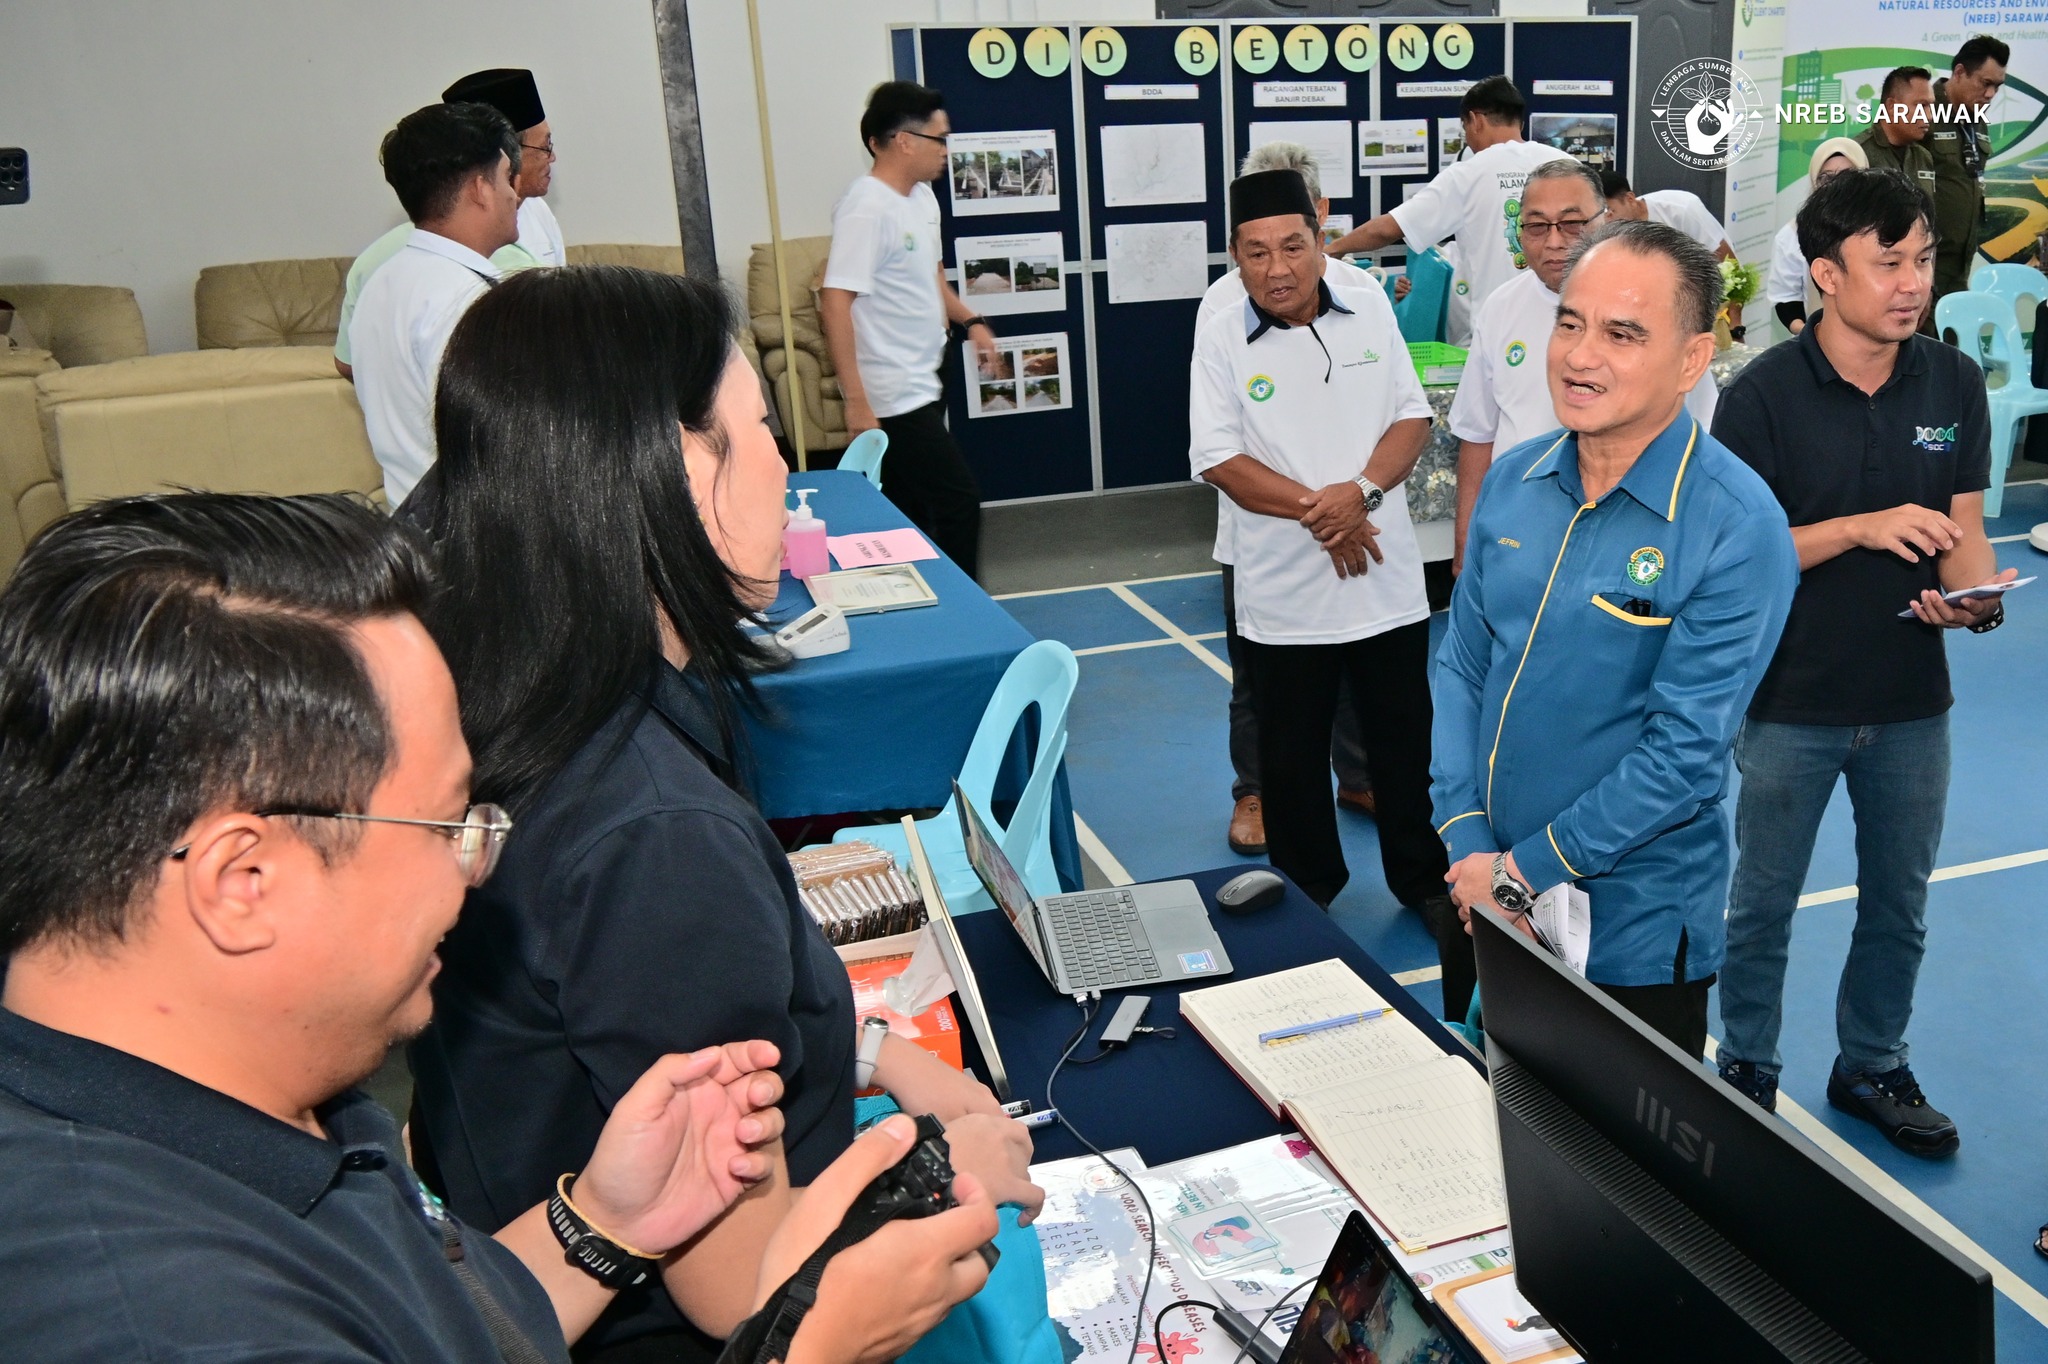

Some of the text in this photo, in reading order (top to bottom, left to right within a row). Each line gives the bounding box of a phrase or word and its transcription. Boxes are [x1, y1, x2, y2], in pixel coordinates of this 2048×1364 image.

[1879, 0, 1929, 10] NATURAL
[1933, 0, 1996, 9] RESOURCES
[2000, 0, 2022, 8] AND
[1963, 11, 2001, 26] (NREB)
[1498, 537, 1520, 549] JEFRIN
[938, 1018, 953, 1031] 200
[1120, 1192, 1139, 1213] WORD
[1131, 1215, 1153, 1243] SEARCH
[1177, 1293, 1207, 1334] DEASES
[1094, 1329, 1110, 1352] CAMPAK
[1107, 1327, 1122, 1347] RABIES
[1120, 1324, 1133, 1342] EBOLA
[1081, 1332, 1097, 1355] TETANUS
